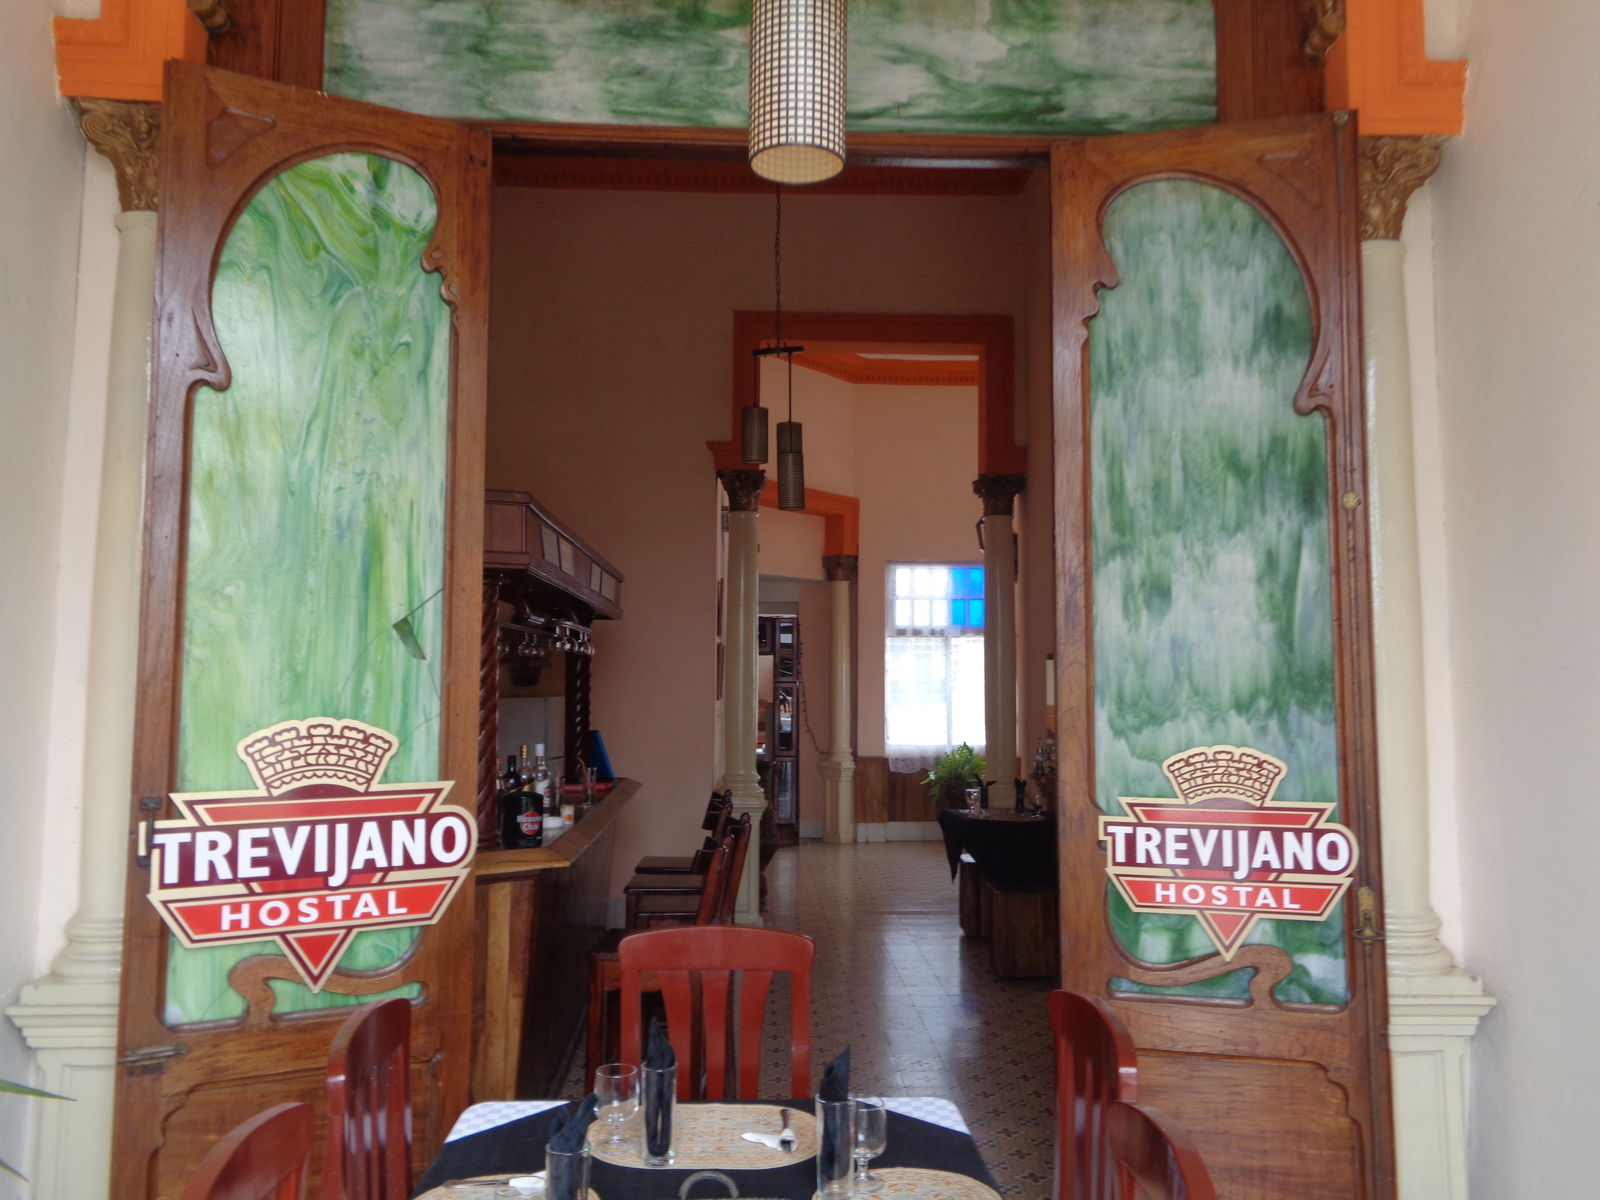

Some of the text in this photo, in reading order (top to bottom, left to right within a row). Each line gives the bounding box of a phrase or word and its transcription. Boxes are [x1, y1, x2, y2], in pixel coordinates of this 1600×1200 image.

[152, 816, 468, 887] TREVIJANO
[1107, 825, 1350, 880] TREVIJANO
[220, 890, 408, 930] HOSTAL
[1155, 883, 1301, 909] HOSTAL
